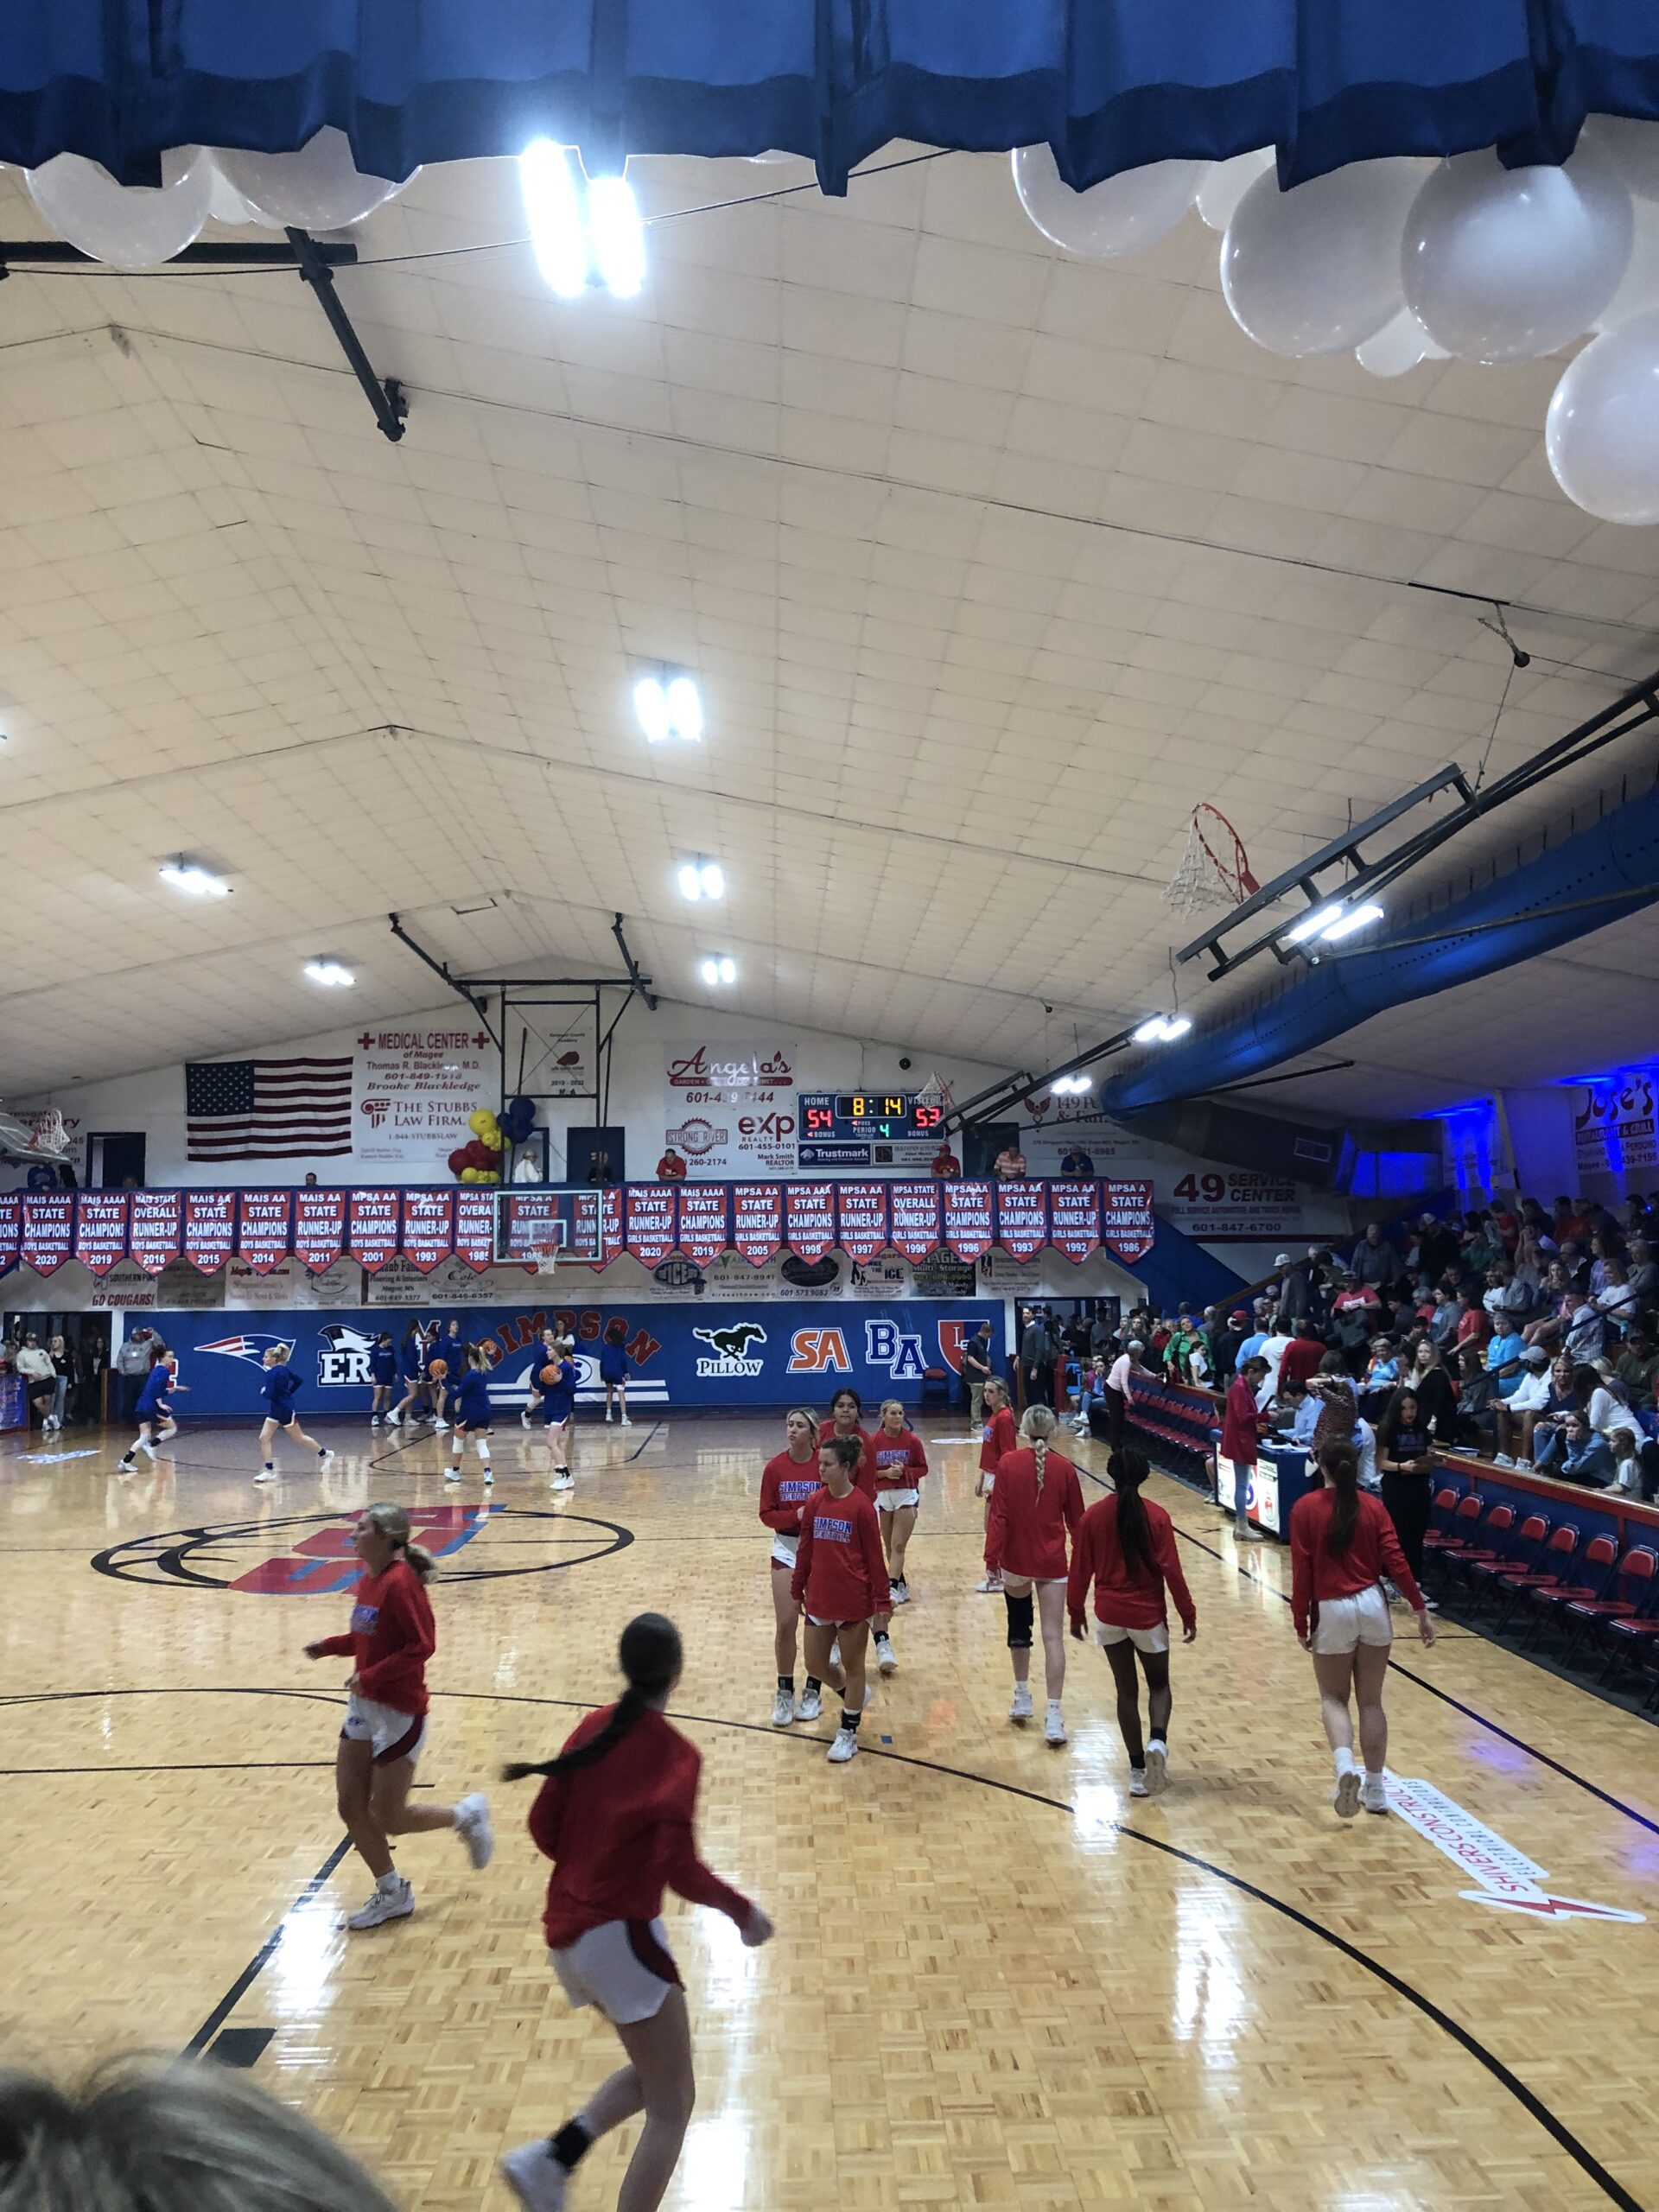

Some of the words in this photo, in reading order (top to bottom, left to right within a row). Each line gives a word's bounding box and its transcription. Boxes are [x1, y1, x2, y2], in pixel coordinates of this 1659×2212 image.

[378, 1033, 424, 1050] MEDICAL
[427, 1033, 469, 1049] CENTER
[414, 1051, 444, 1060] Magee
[366, 1061, 400, 1071] Thomas
[462, 1060, 481, 1070] M.D.
[366, 1082, 410, 1090] Brooke
[414, 1082, 481, 1092] Blackledge
[393, 1101, 423, 1113] THE
[427, 1101, 478, 1113] STUBBS
[804, 1096, 830, 1106] HOME
[394, 1114, 423, 1127] LAW
[807, 1109, 833, 1128] 54
[915, 1108, 941, 1128] 53
[879, 1122, 890, 1138] 4
[669, 1132, 698, 1142] STRONG
[815, 1148, 869, 1158] Trustmark
[680, 1188, 701, 1197] MAIS
[702, 1188, 725, 1197] AAAA
[893, 1185, 912, 1194] MPSA
[913, 1185, 936, 1194] STATE
[1108, 1184, 1136, 1192] MPSA
[1138, 1184, 1147, 1192] A
[1173, 1173, 1225, 1203] 49
[1228, 1173, 1295, 1187] SERVICE
[26, 1196, 47, 1205] MAIS
[48, 1196, 72, 1205] AAAA
[352, 1192, 378, 1202] MPSA
[382, 1192, 397, 1202] AA
[1230, 1188, 1295, 1202] CENTER
[634, 1200, 668, 1212] STATE
[686, 1200, 720, 1211] STATE
[741, 1198, 773, 1211] STATE
[793, 1198, 827, 1210] STATE
[845, 1198, 879, 1209] STATE
[893, 1198, 936, 1209] OVERALL
[950, 1197, 984, 1208] STATE
[1004, 1196, 1038, 1207] STATE
[1058, 1196, 1091, 1207] STATE
[1111, 1196, 1145, 1208] STATE
[32, 1208, 66, 1220] STATE
[86, 1207, 120, 1219] STATE
[133, 1206, 178, 1218] OVERALL
[194, 1206, 227, 1218] STATE
[248, 1206, 282, 1217] STATE
[303, 1205, 337, 1217] STATE
[358, 1205, 391, 1217] STATE
[411, 1204, 444, 1217] STATE
[628, 1216, 672, 1230] RUNNER-UP
[680, 1215, 726, 1230] CHAMPIONS
[735, 1214, 779, 1229] RUNNER-UP
[787, 1213, 833, 1228] CHAMPIONS
[840, 1212, 884, 1228] RUNNER-UP
[893, 1212, 937, 1227] RUNNER-UP
[945, 1211, 990, 1226] CHAMPIONS
[999, 1211, 1045, 1226] CHAMPIONS
[1052, 1211, 1097, 1226] RUNNER-UP
[1105, 1211, 1151, 1226] CHAMPIONS
[24, 1223, 71, 1238] CHAMPIONS
[79, 1223, 125, 1238] CHAMPIONS
[132, 1222, 177, 1237] RUNNER-UP
[186, 1222, 233, 1237] CHAMPIONS
[240, 1221, 288, 1236] CHAMPIONS
[297, 1220, 343, 1236] RUNNER-UP
[350, 1219, 397, 1235] CHAMPIONS
[404, 1219, 450, 1235] RUNNER-UP
[695, 1233, 726, 1243] BASKETBALL
[38, 1242, 69, 1252] BASKETBALL
[639, 1247, 662, 1257] 2020
[692, 1246, 715, 1256] 2019
[747, 1245, 769, 1255] 2005
[800, 1244, 822, 1255] 1998
[852, 1243, 874, 1255] 1997
[905, 1243, 927, 1254] 1996
[957, 1243, 980, 1253] 1996
[1011, 1242, 1033, 1252] 1993
[1065, 1242, 1087, 1253] 1992
[1118, 1242, 1141, 1252] 1986
[35, 1255, 58, 1266] 2020
[89, 1254, 112, 1265] 2019
[142, 1254, 166, 1264] 2016
[196, 1254, 220, 1265] 2015
[251, 1253, 275, 1264] 2014
[308, 1252, 330, 1262] 2011
[361, 1251, 385, 1262] 2001
[415, 1251, 437, 1262] 1993
[884, 1268, 905, 1280] ICE
[939, 1264, 973, 1273] Storage
[109, 1274, 142, 1282] SOUTHERN
[92, 1294, 105, 1306] GO
[107, 1294, 155, 1306] COUGARS!
[788, 1328, 851, 1372] SA
[868, 1322, 925, 1376] BA
[699, 1360, 761, 1374] PILLOW
[876, 1450, 910, 1459] SIMPSON
[779, 1480, 822, 1493] SIMPSON
[813, 1516, 853, 1535] SIMPSON
[1381, 1774, 1464, 1842] CONSTRUCTI
[1402, 1780, 1473, 1827] CONTRACTORS
[1465, 1829, 1537, 1876] ELECTRICAL
[1447, 1842, 1529, 1892] SHIVERS
